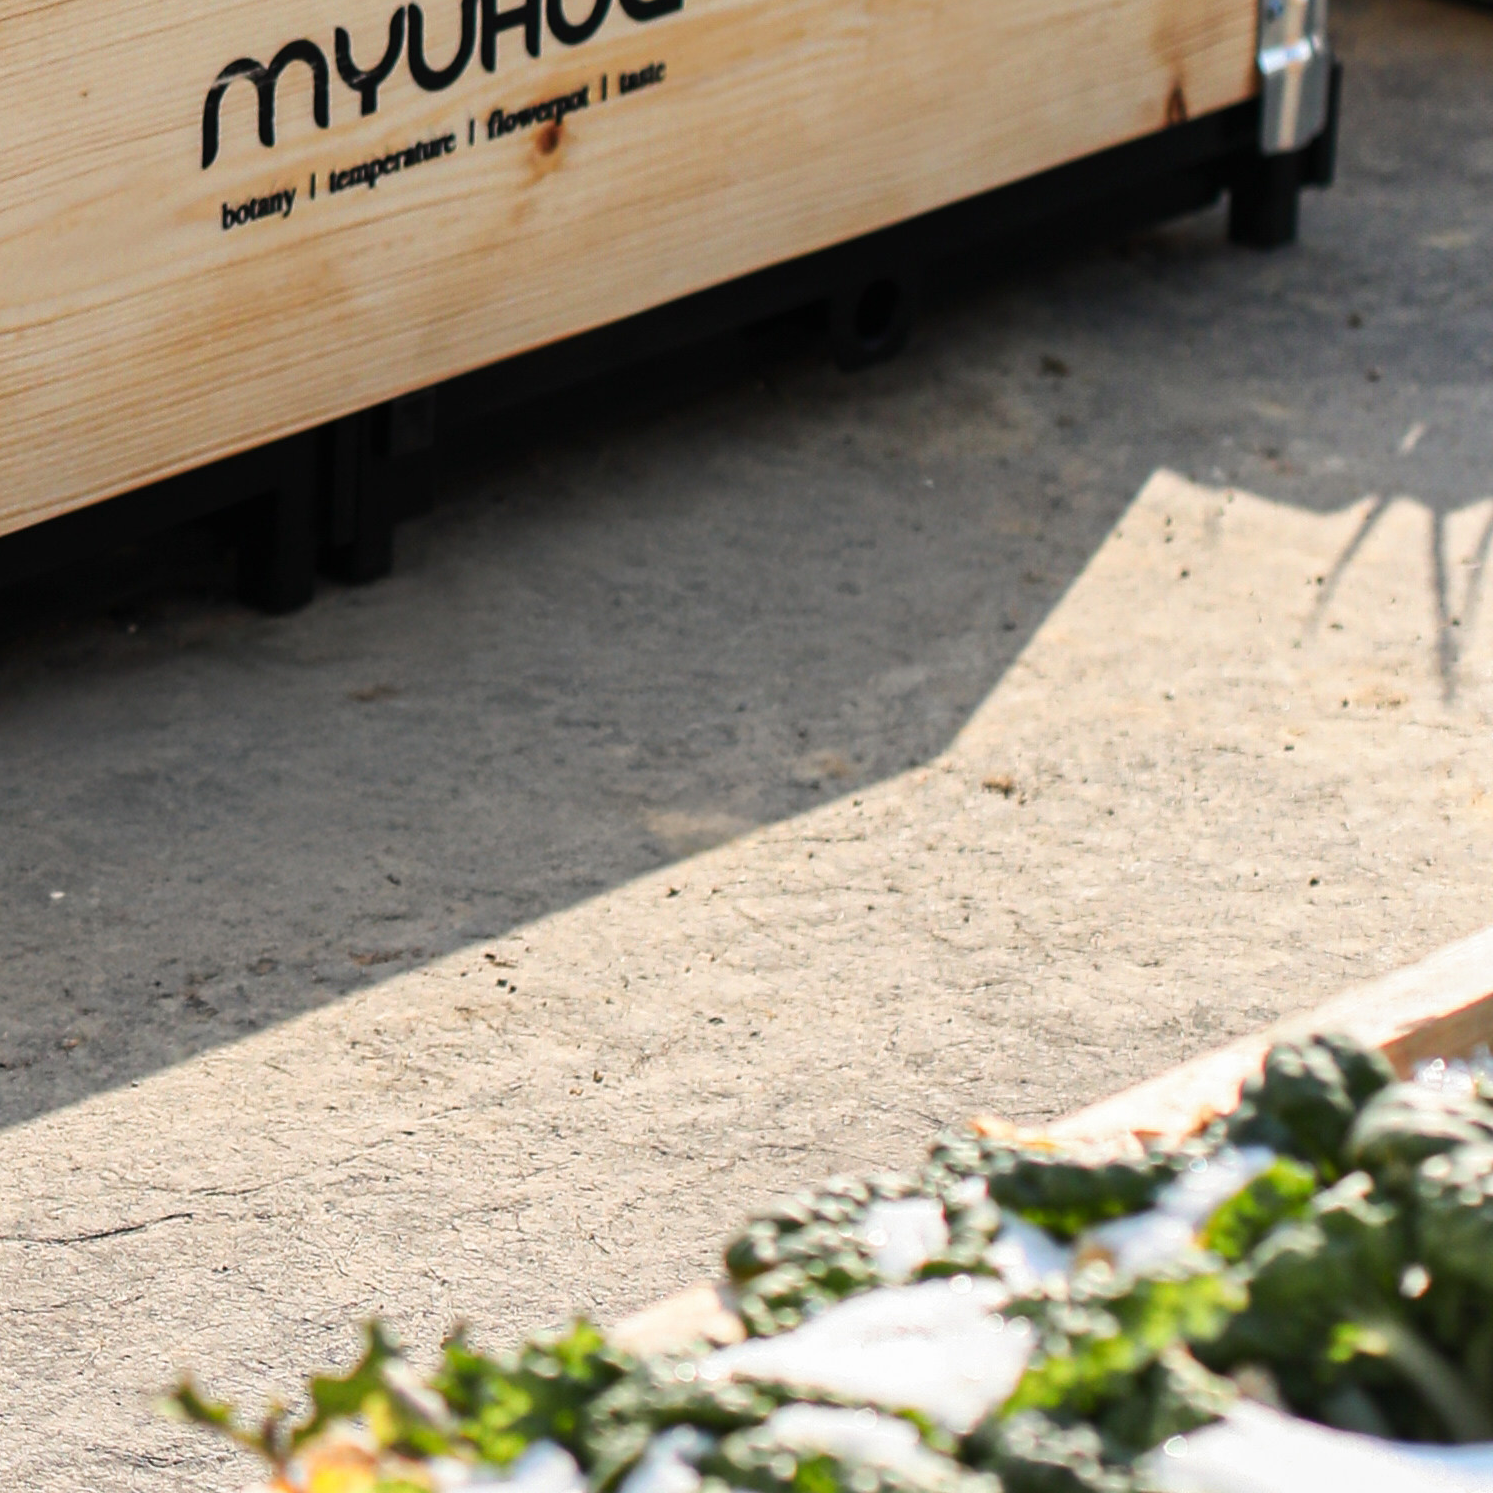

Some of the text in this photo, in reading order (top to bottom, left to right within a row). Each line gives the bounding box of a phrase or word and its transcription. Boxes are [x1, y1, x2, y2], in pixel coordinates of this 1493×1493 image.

[221, 62, 667, 230] botany temperature flowerpot taste
